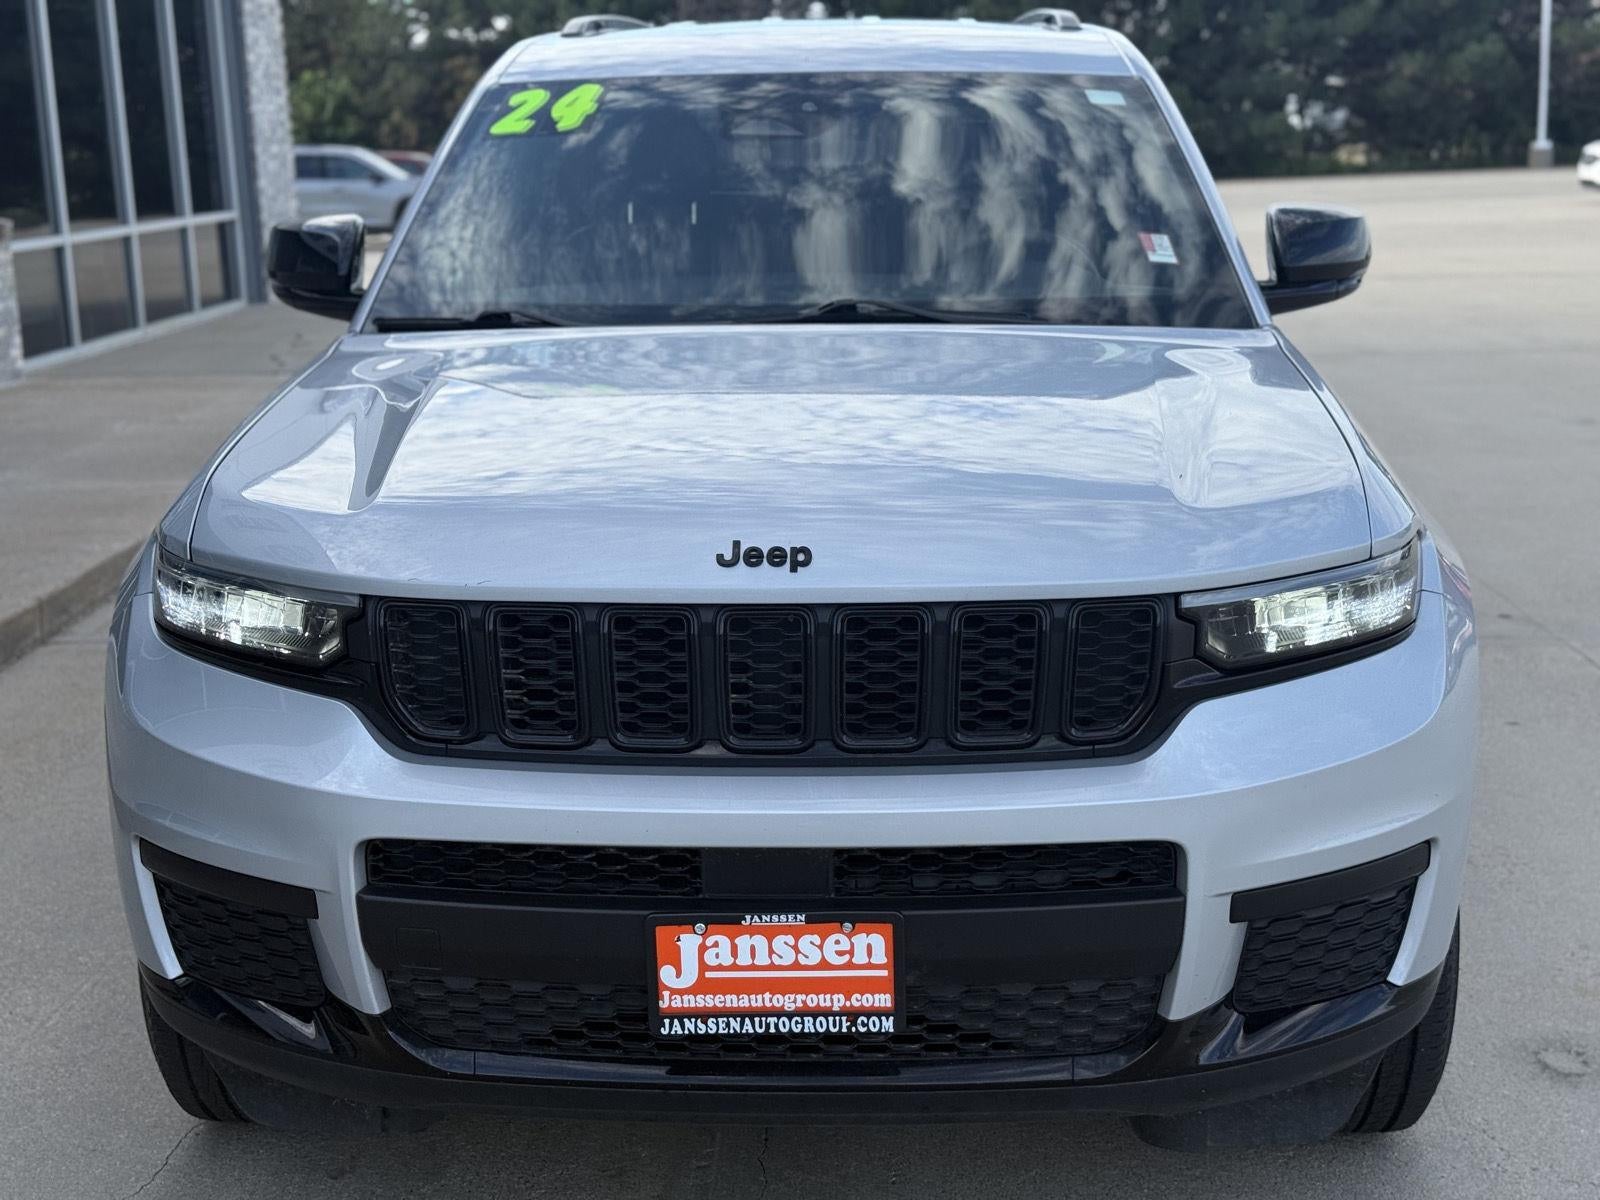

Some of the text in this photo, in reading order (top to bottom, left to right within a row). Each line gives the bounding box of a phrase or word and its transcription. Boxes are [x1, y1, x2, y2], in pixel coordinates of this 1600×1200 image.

[489, 83, 604, 135] 24
[716, 540, 813, 573] Jeep
[741, 914, 806, 925] JANSSEN
[660, 933, 888, 988] Janssen
[659, 990, 892, 1011] Janssenautogroup.com
